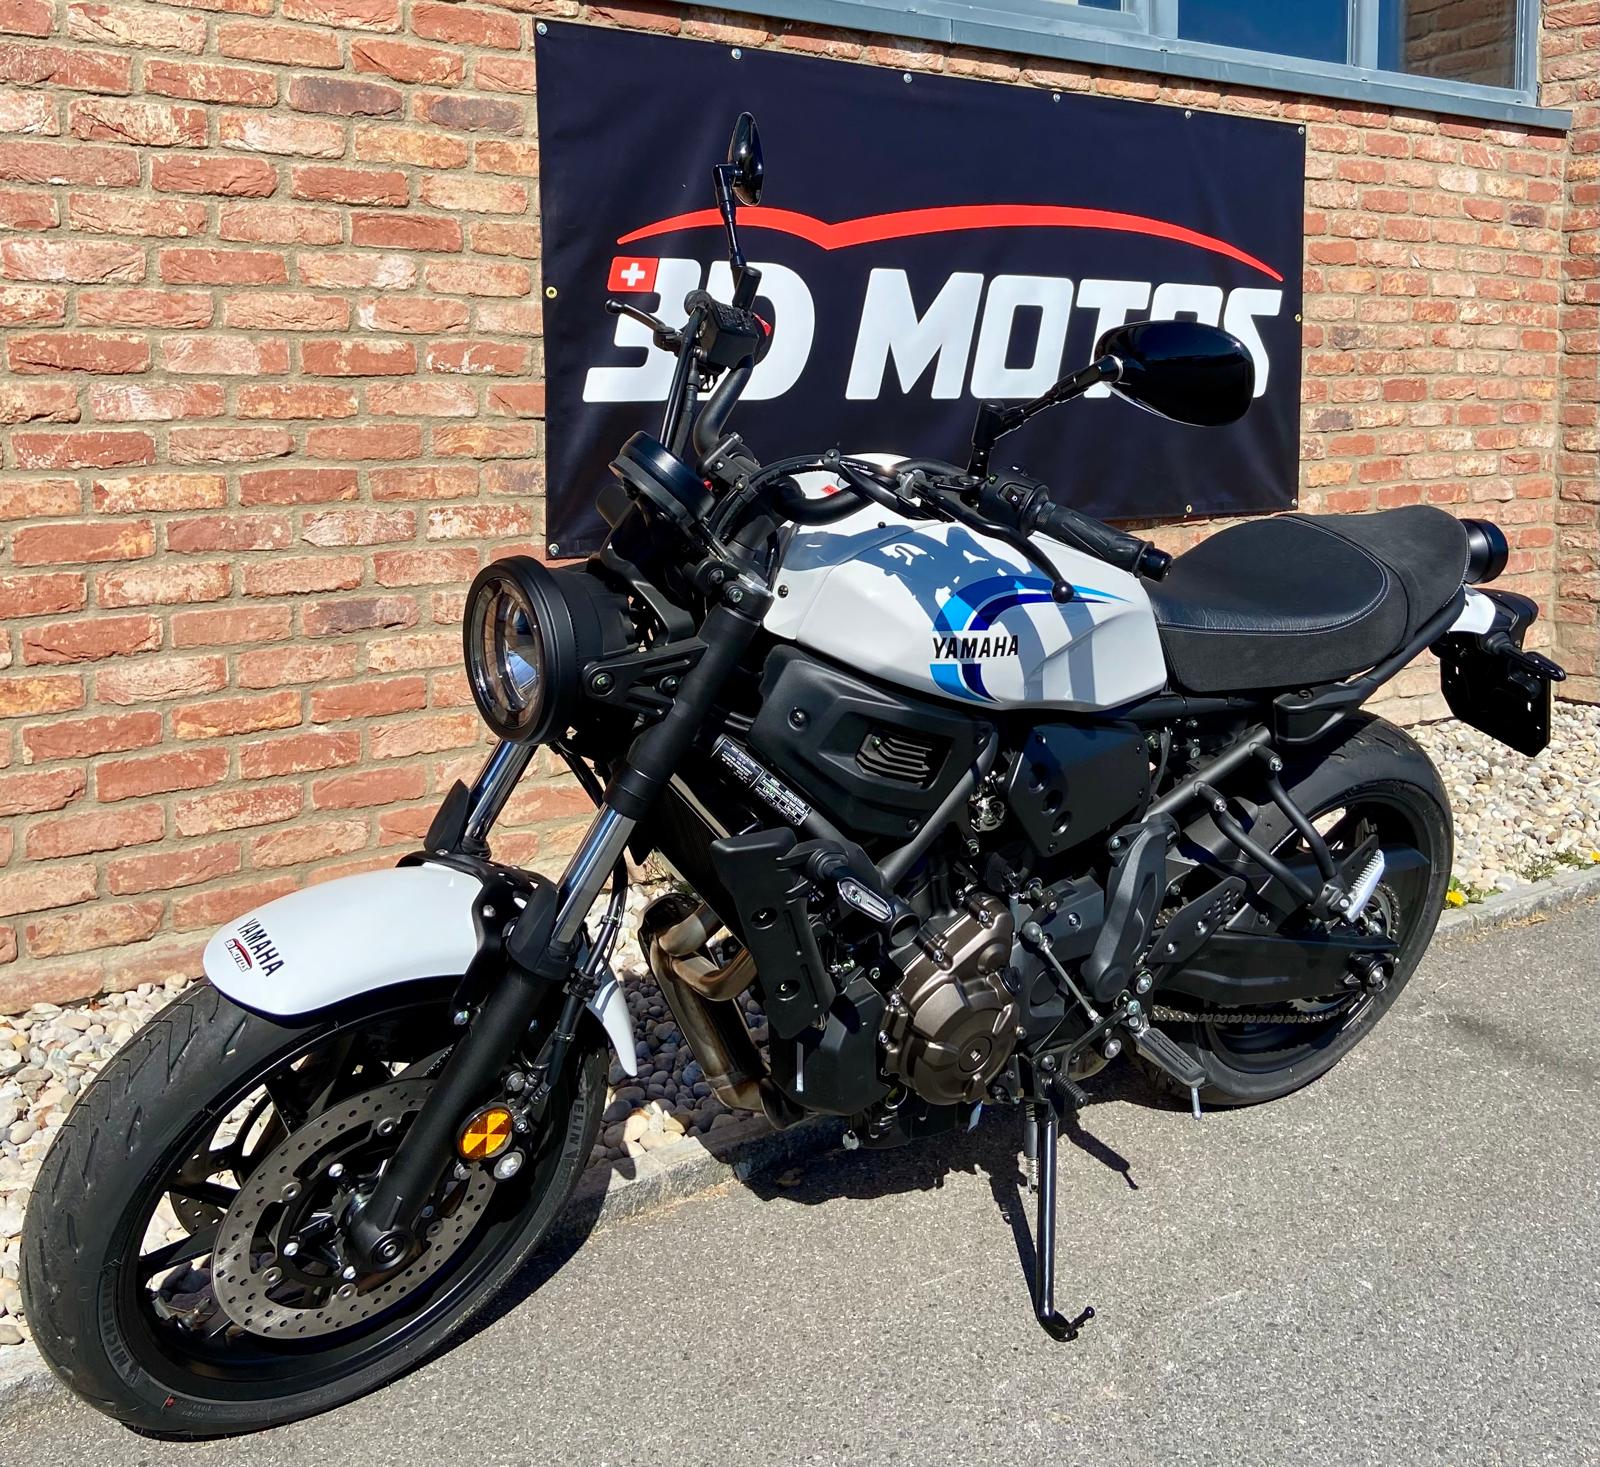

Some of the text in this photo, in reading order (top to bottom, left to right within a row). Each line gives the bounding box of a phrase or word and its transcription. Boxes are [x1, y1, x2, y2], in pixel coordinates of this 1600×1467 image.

[583, 256, 814, 402] 3D
[932, 635, 1019, 659] YAMAHA
[237, 918, 285, 977] YAMAHA
[101, 1277, 130, 1368] MICHELIN
